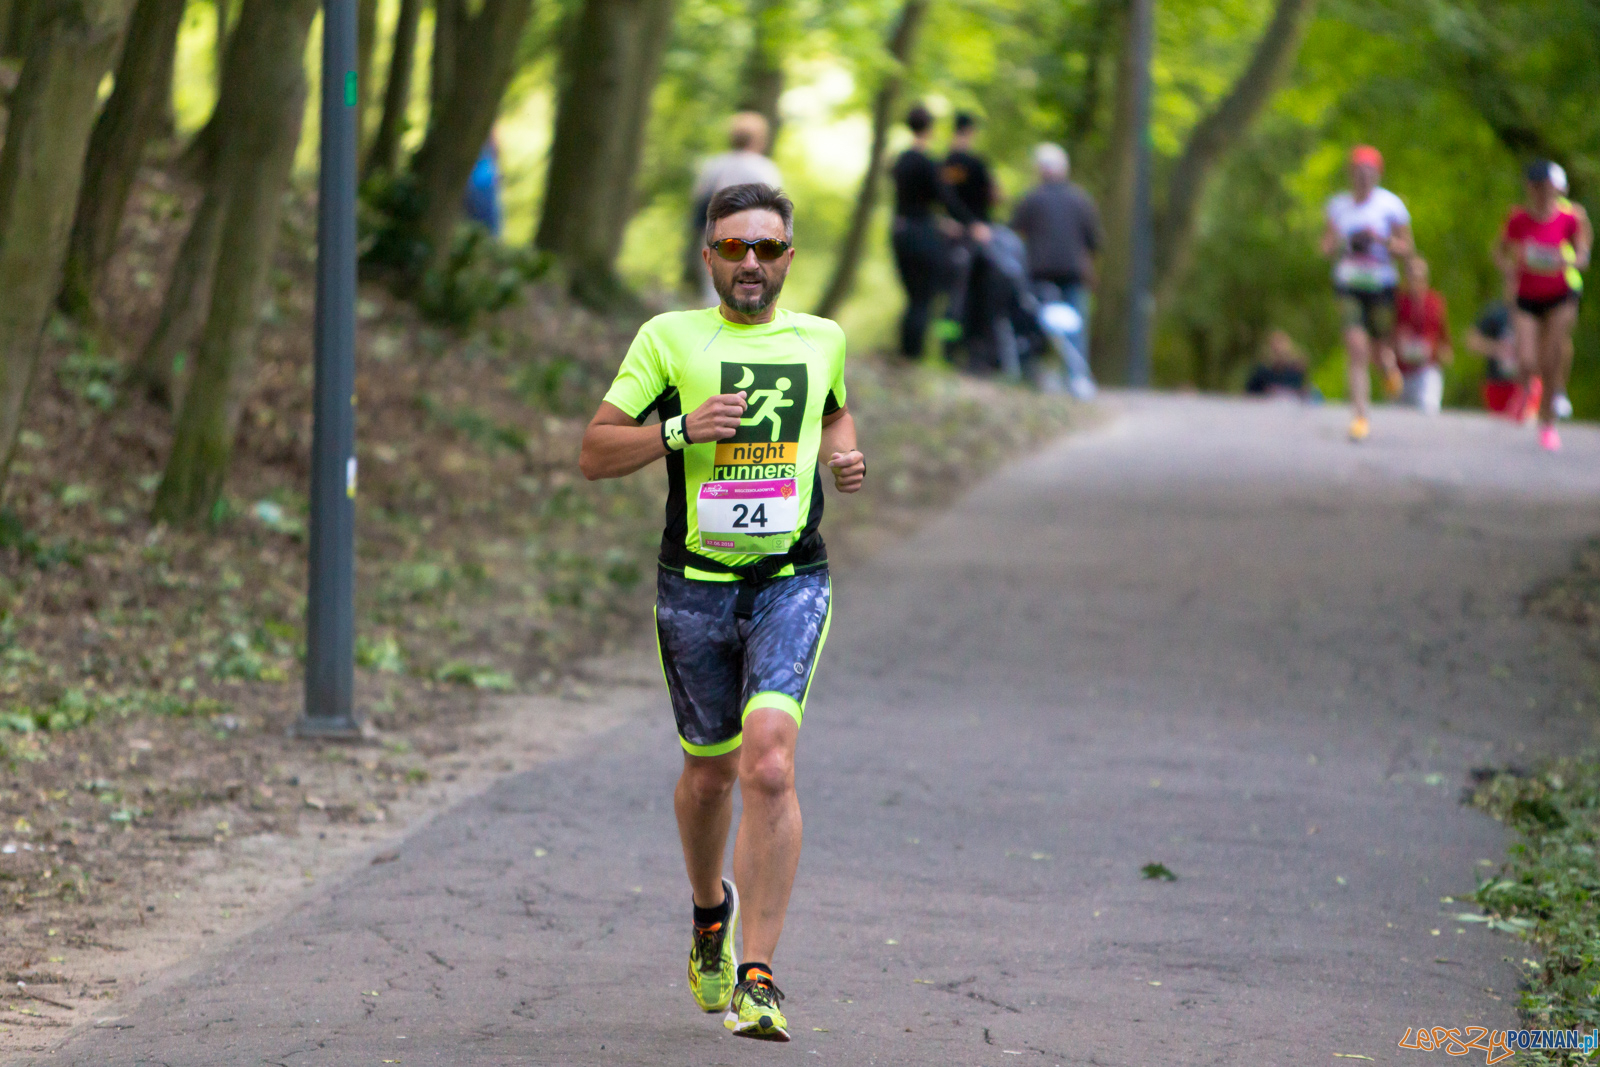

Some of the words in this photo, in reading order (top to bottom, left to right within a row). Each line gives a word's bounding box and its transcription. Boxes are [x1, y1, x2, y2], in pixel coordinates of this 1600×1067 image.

[734, 443, 785, 464] night
[714, 464, 795, 479] runners
[732, 503, 768, 528] 24
